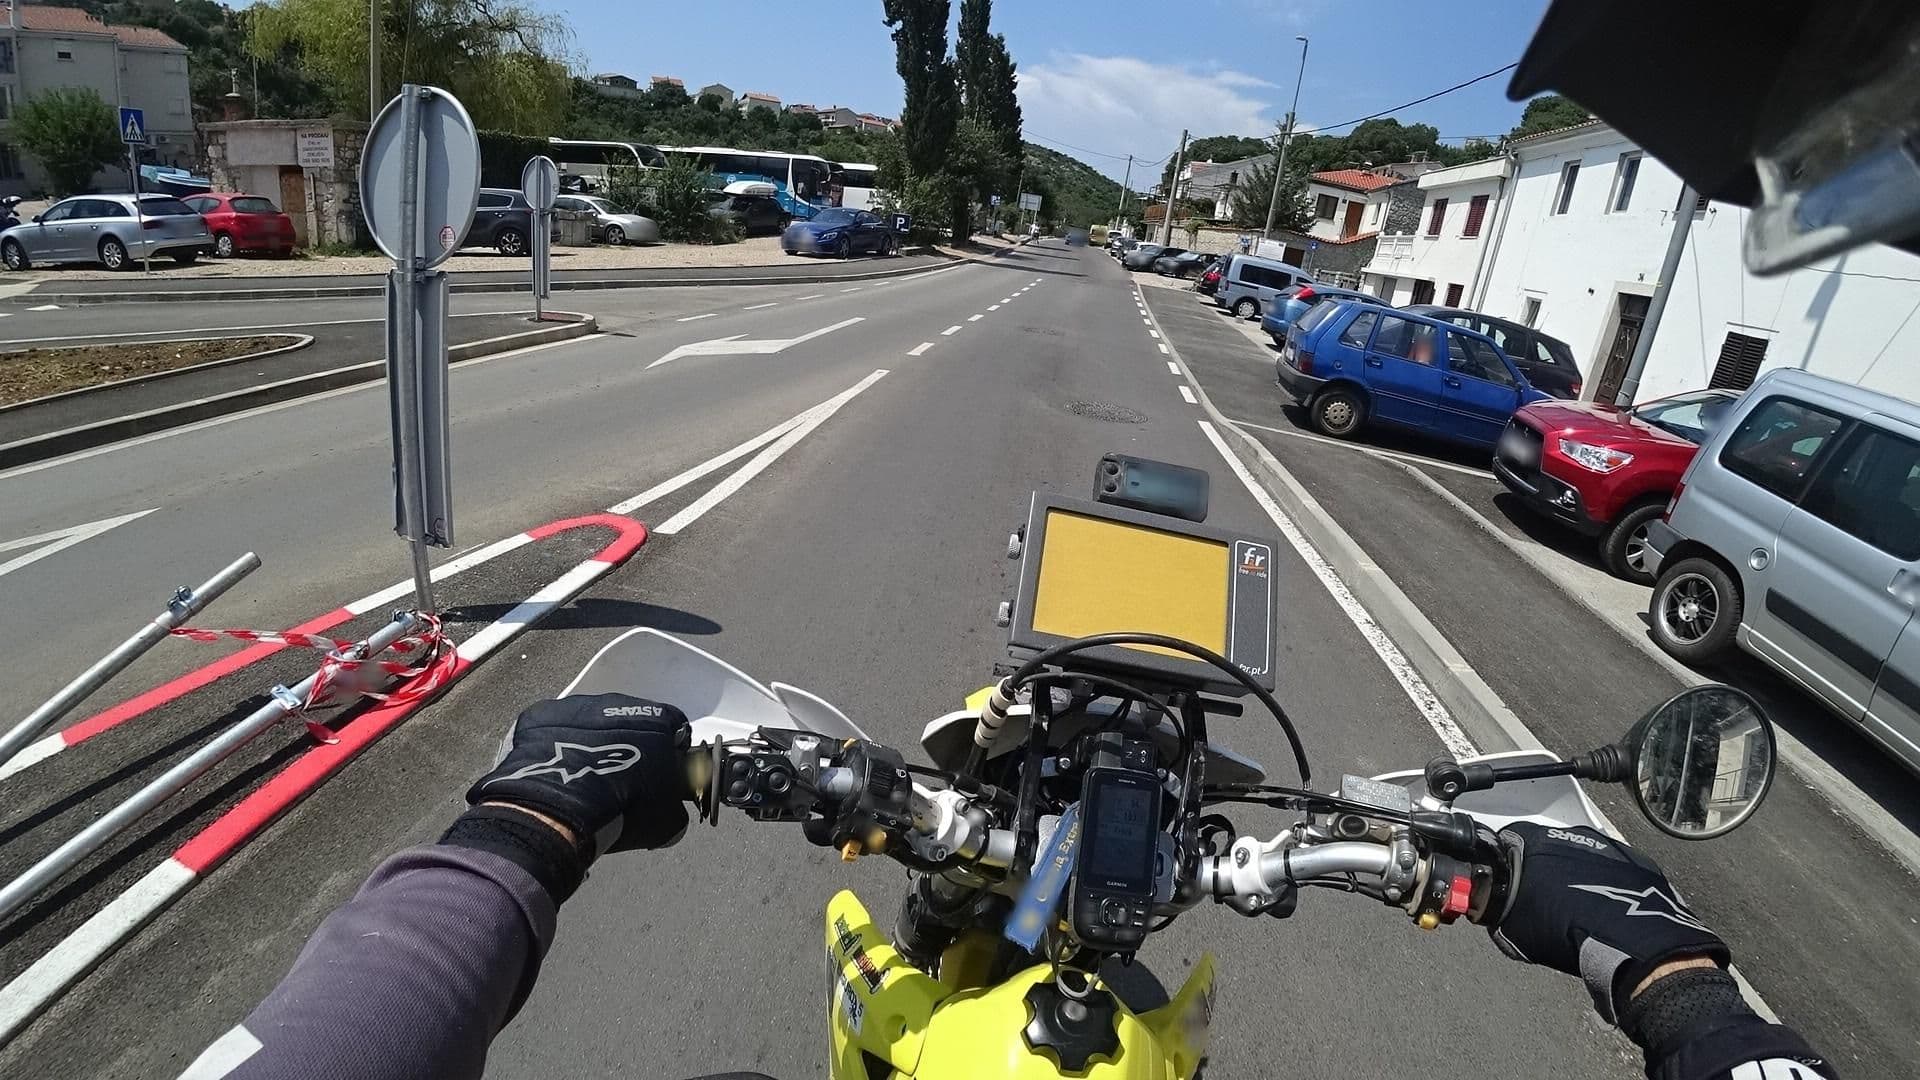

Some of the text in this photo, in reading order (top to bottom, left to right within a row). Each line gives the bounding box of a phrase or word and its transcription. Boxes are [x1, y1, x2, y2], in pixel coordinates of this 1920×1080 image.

[896, 217, 905, 229] P
[603, 706, 663, 717] ASTARS
[1547, 828, 1608, 850] ASTARS
[1106, 880, 1127, 888] GARMIN
